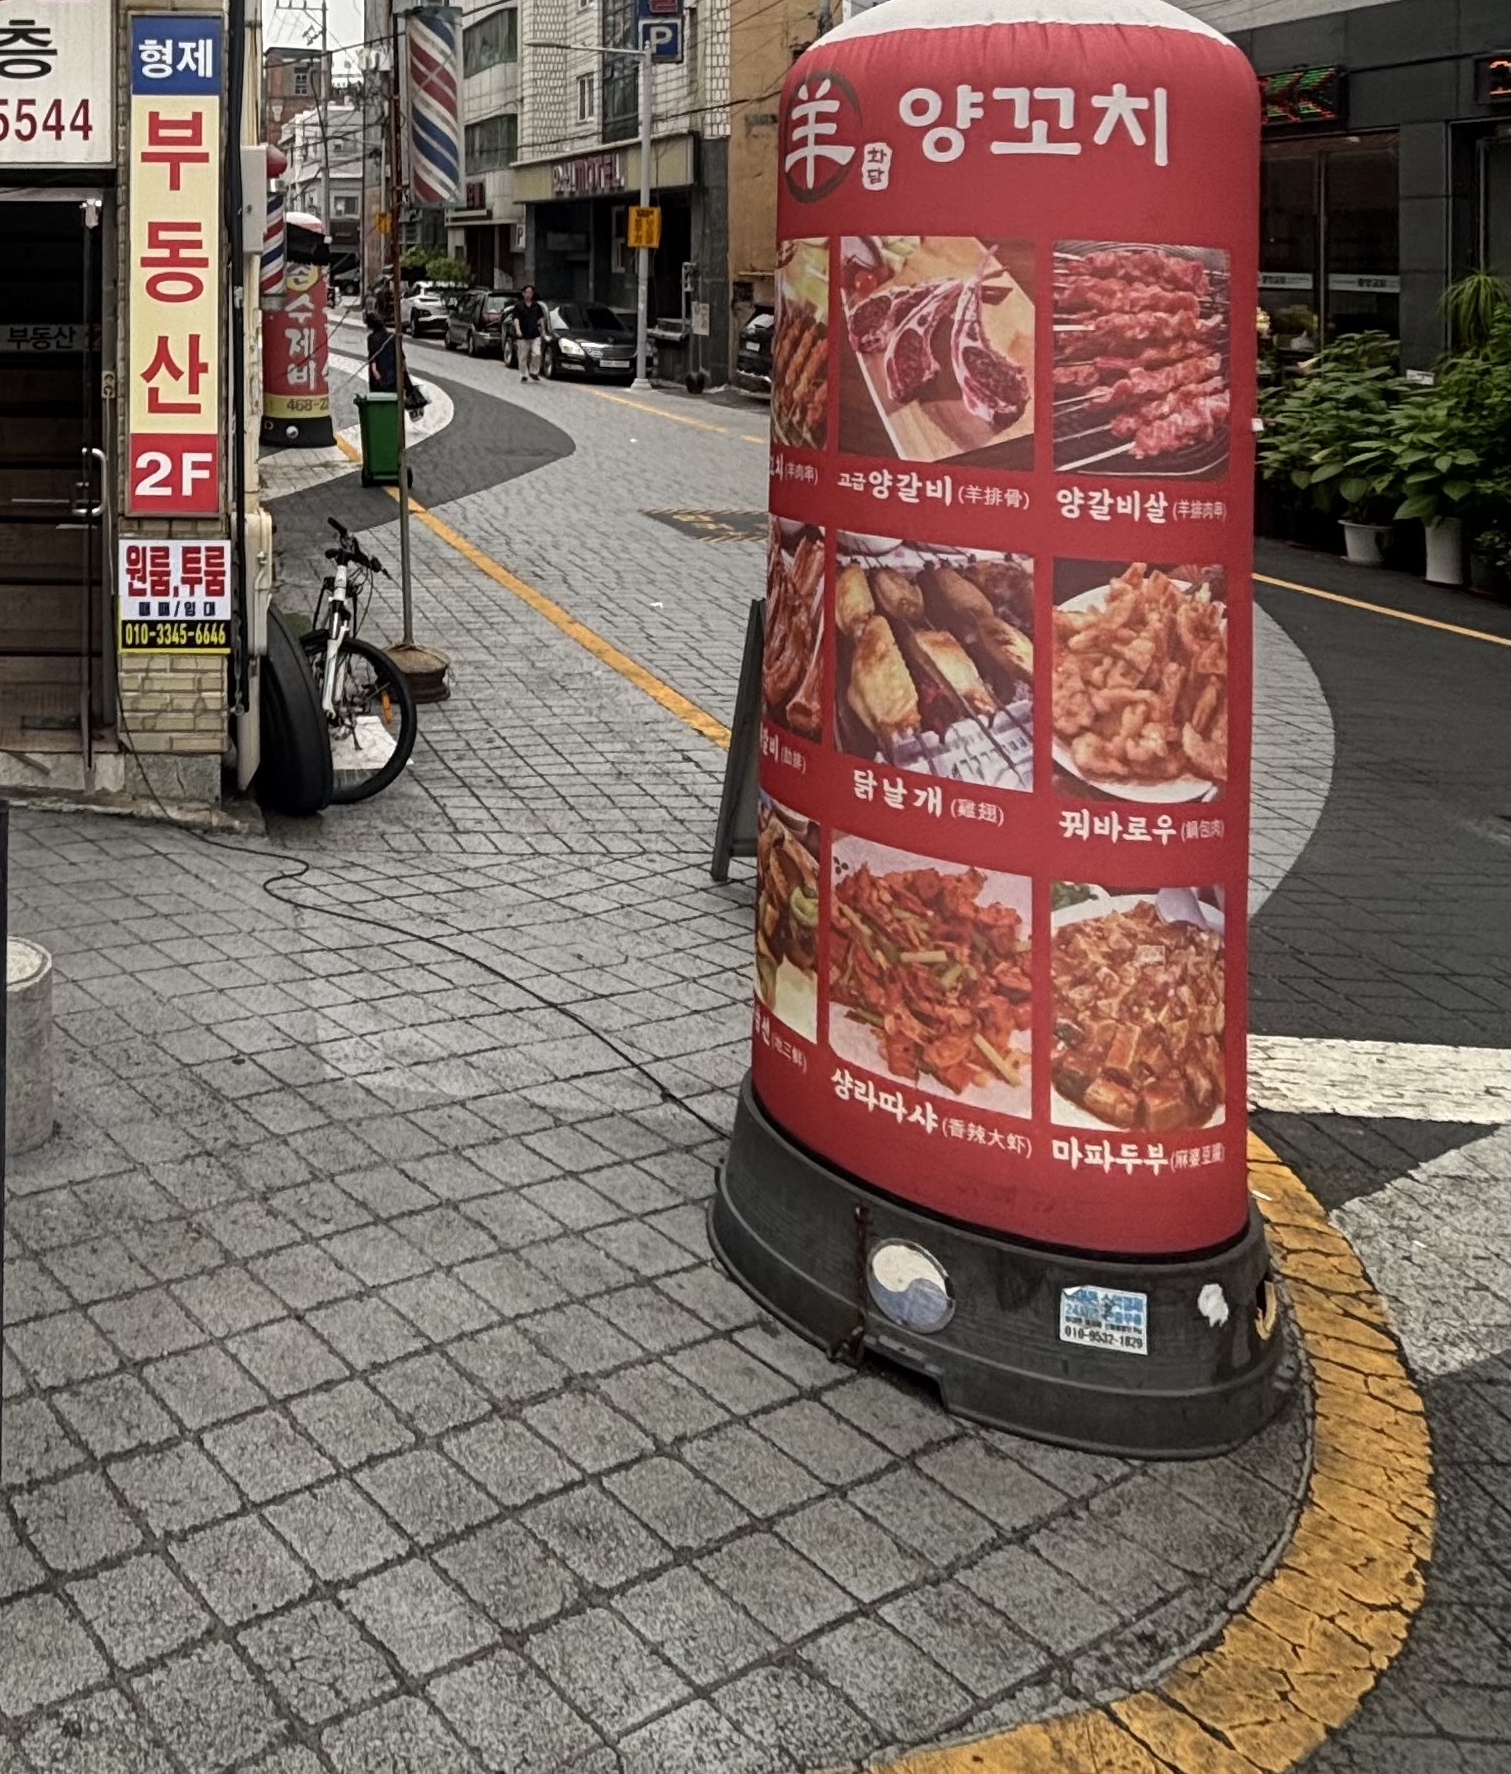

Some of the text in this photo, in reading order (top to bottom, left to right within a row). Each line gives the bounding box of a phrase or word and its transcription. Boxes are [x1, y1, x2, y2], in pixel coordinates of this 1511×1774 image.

[138, 39, 214, 79] 형제
[650, 24, 674, 56] P
[785, 78, 856, 189] 羊
[899, 84, 1169, 167] 양꼬치
[140, 111, 210, 415] 부동산
[7, 325, 76, 351] 부동산
[135, 451, 213, 497] 2F
[1057, 487, 1169, 524] 양갈비살
[125, 623, 226, 645] 010-3345-6646
[853, 768, 945, 817] 닭날개
[1058, 810, 1177, 844] 꿔바로우
[1051, 1137, 1169, 1175] 마파두부
